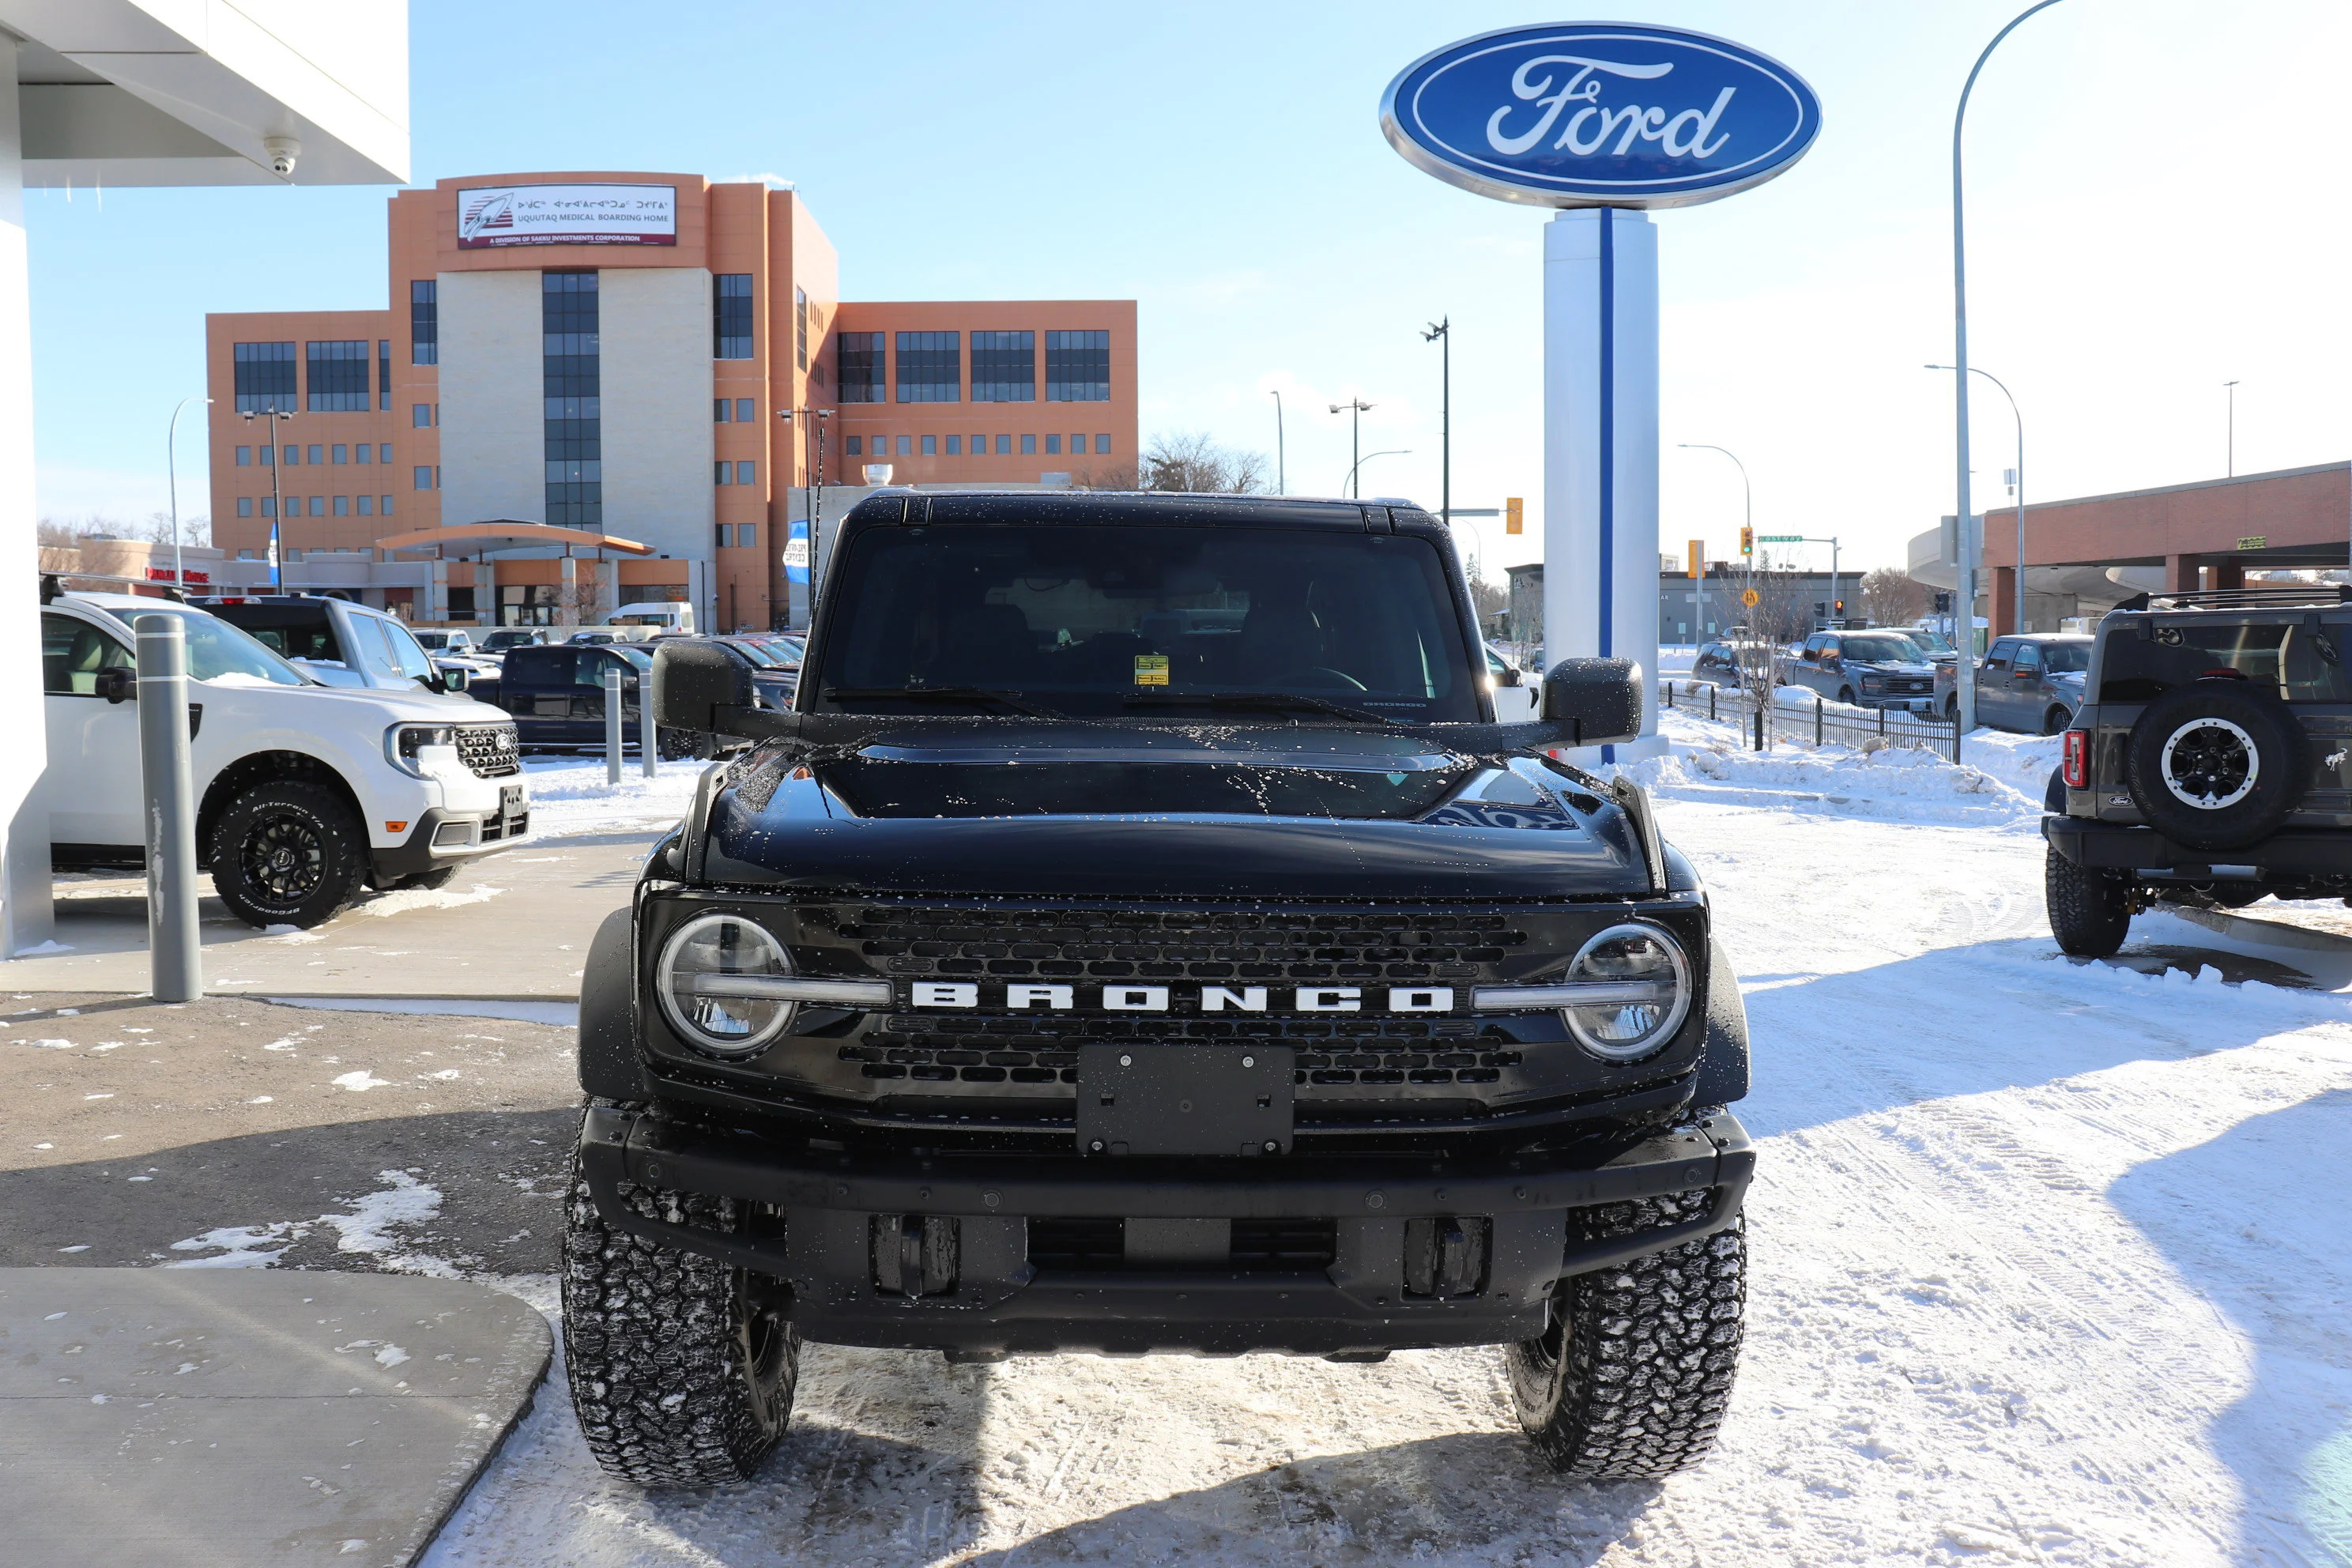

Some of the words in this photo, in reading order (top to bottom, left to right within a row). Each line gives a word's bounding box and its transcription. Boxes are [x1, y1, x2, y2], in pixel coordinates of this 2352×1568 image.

[1486, 55, 1736, 159] Ford
[518, 214, 558, 223] UQUUTAQ
[252, 801, 308, 813] All-Terrain
[311, 814, 324, 829] T/A
[239, 894, 300, 915] BFGoodrich
[911, 980, 1455, 1012] BRONCO
